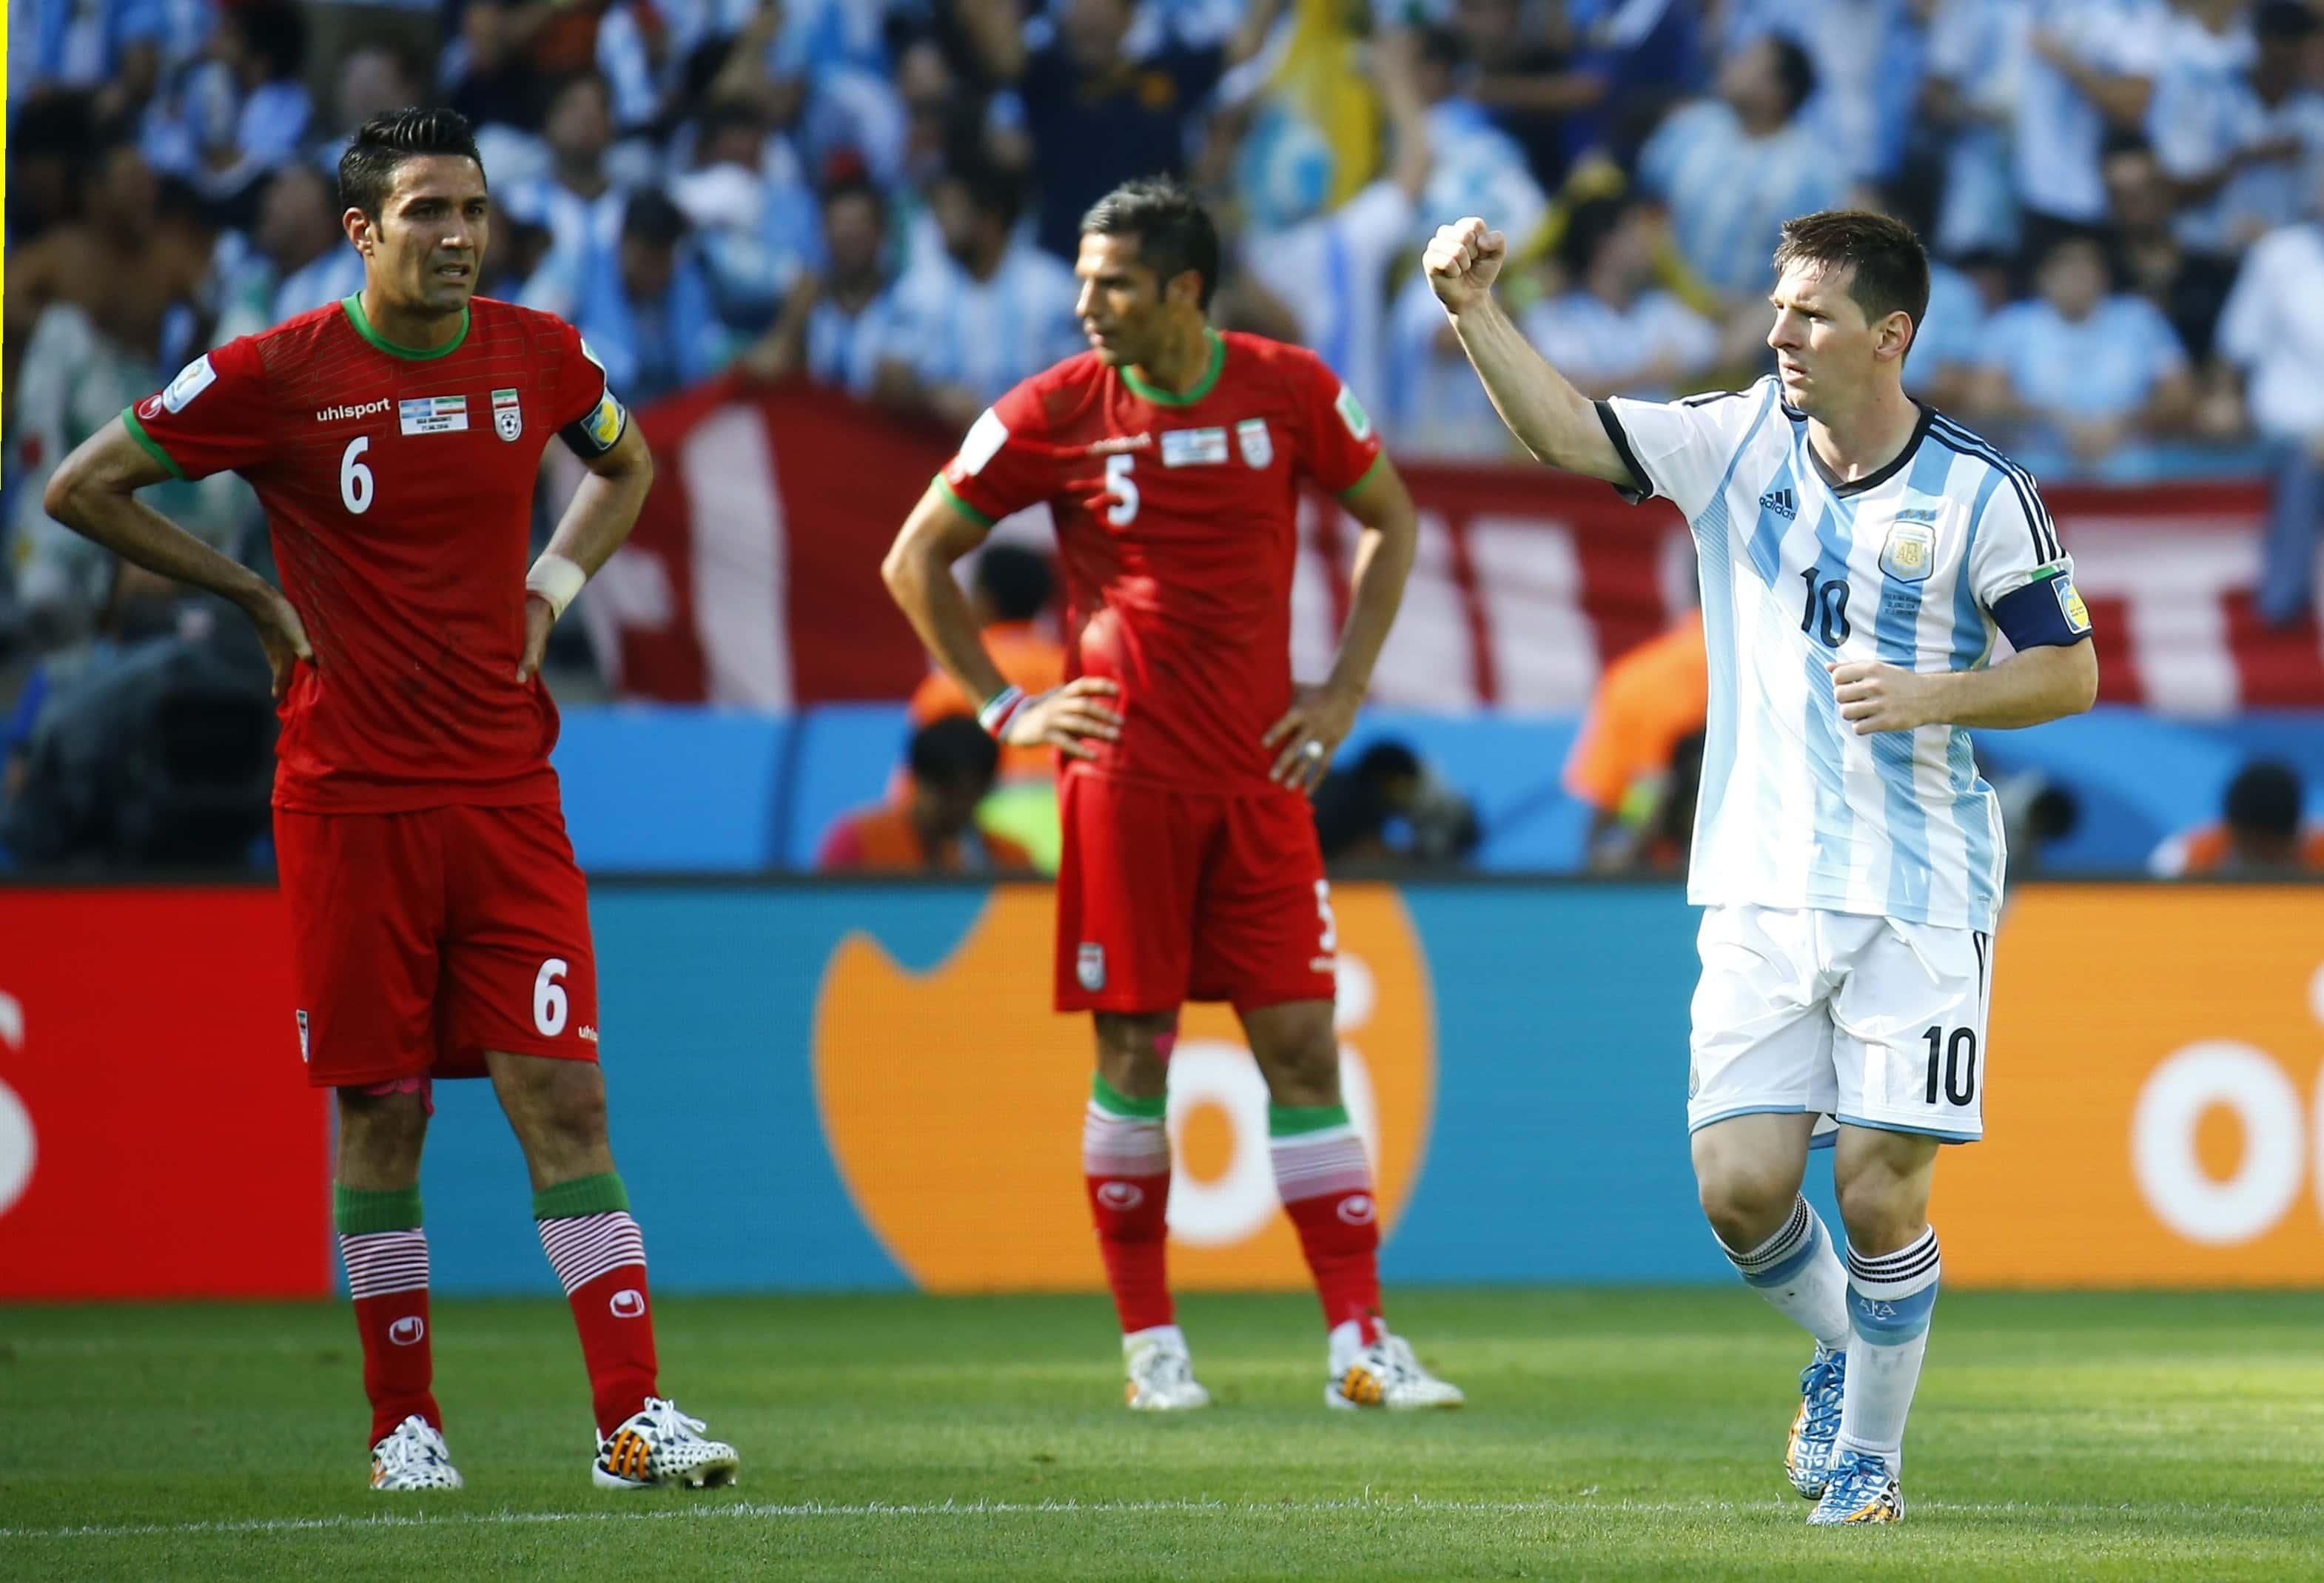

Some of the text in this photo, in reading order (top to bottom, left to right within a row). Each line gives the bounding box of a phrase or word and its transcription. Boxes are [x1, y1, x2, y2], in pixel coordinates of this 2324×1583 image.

[317, 397, 392, 423] uhlsport
[340, 435, 374, 514] 6
[1106, 454, 1141, 527] 5
[1759, 497, 1797, 522] adidas
[1799, 567, 1851, 648] 10
[533, 958, 568, 1037] 6
[1922, 1026, 1977, 1106] 10
[2130, 958, 2324, 1246] o
